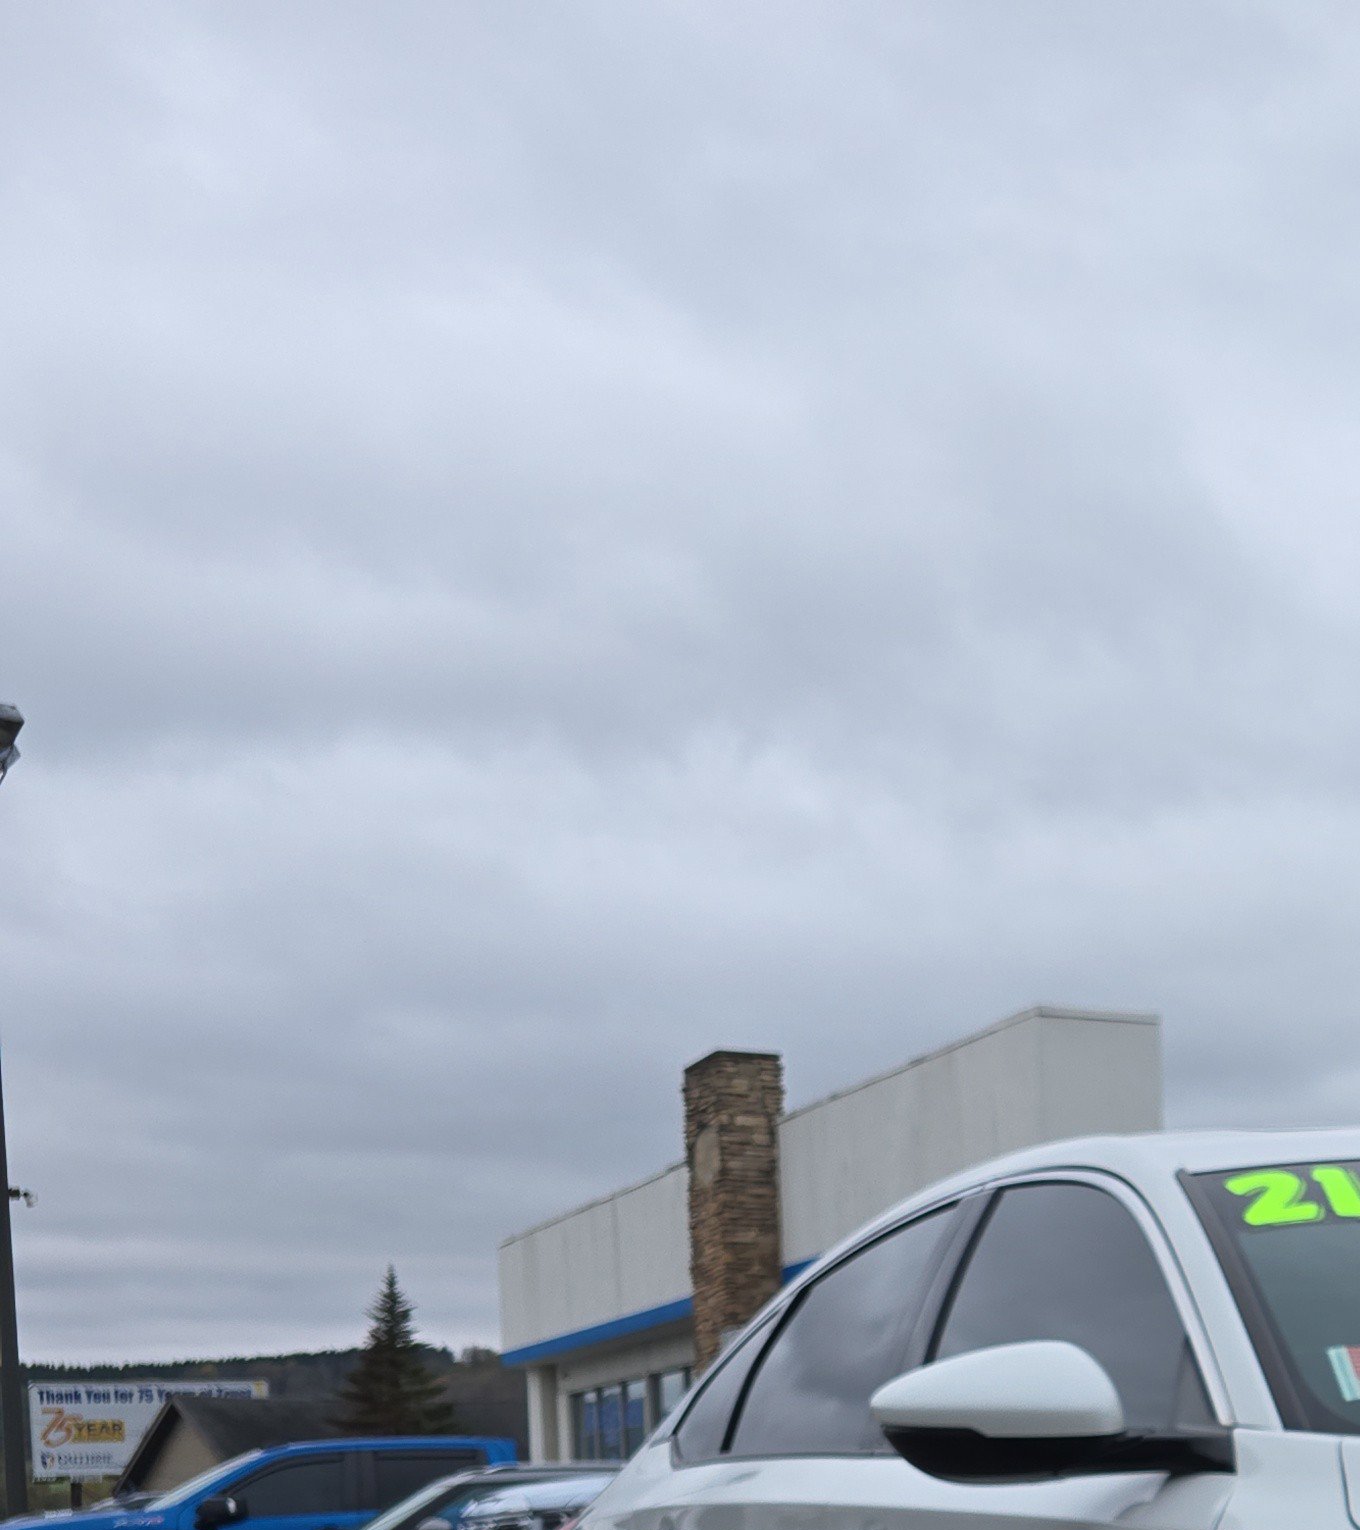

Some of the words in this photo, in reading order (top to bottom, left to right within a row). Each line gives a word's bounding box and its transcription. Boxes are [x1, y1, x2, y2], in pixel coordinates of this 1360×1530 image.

[38, 1389, 82, 1404] Thank
[85, 1390, 111, 1404] You
[113, 1389, 134, 1404] for
[137, 1389, 154, 1403] 75
[40, 1407, 83, 1448] 75
